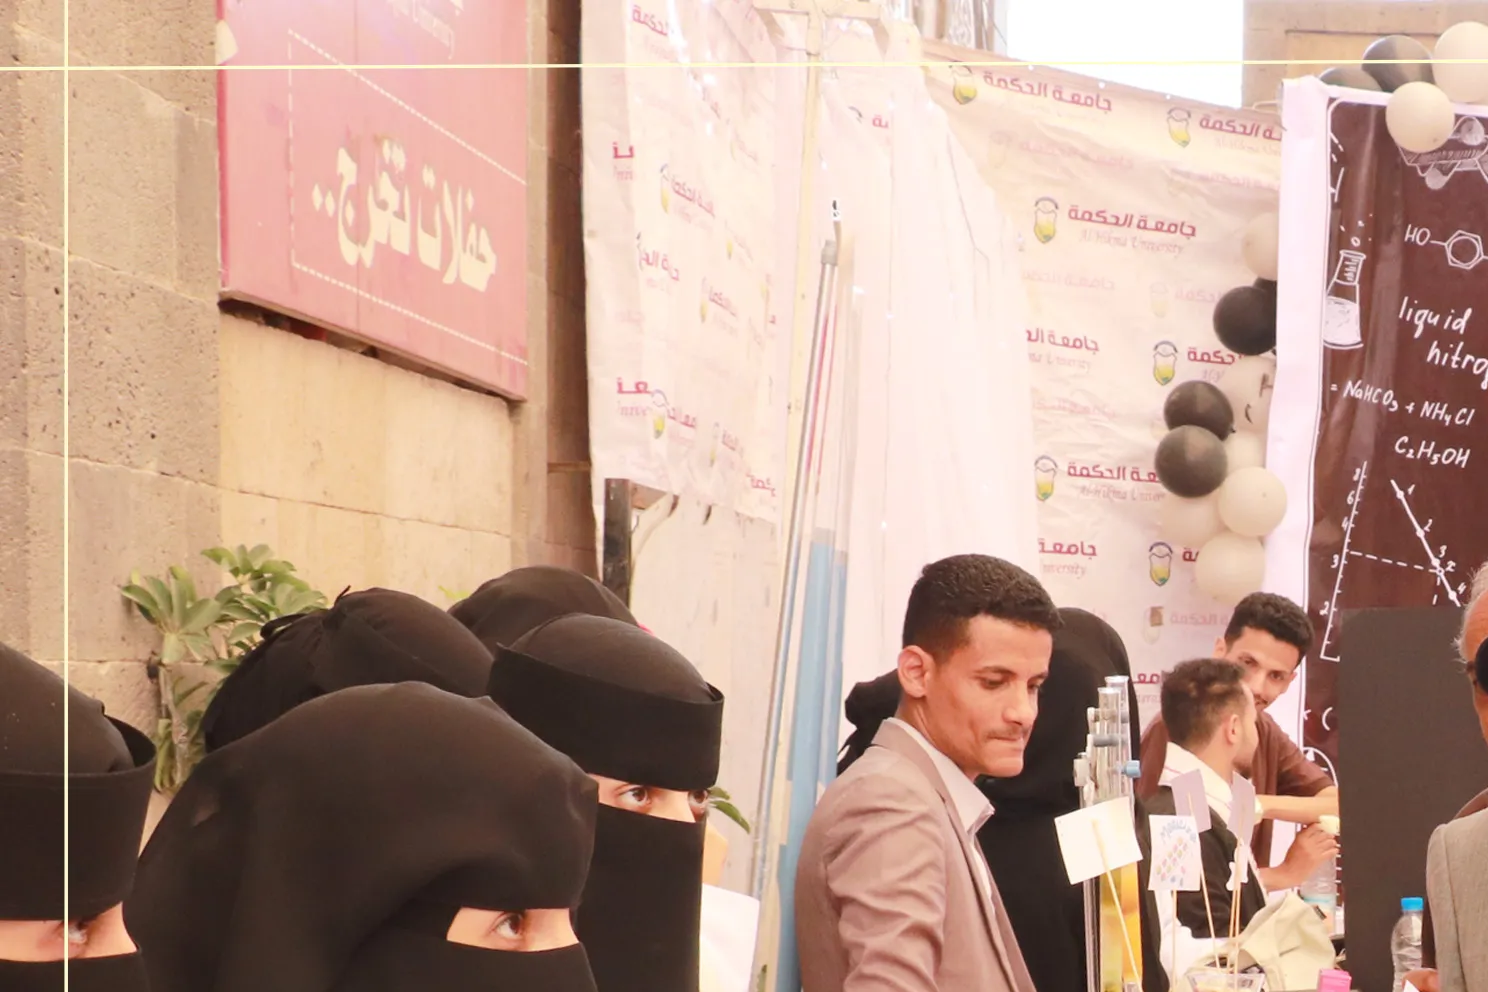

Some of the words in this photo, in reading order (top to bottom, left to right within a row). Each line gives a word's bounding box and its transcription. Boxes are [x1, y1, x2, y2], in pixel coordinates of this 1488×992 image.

[983, 71, 1048, 98] الحكمة
[1052, 85, 1112, 115] جامعة
[1199, 114, 1260, 138] الحكمة
[1067, 204, 1133, 229] الحكمة
[1136, 217, 1197, 240] جامعة
[1404, 224, 1431, 246] HO
[1398, 296, 1473, 339] liquid
[1047, 328, 1100, 357] جامعة
[1394, 435, 1471, 469] C2H5OH
[1067, 461, 1127, 482] الحكمة
